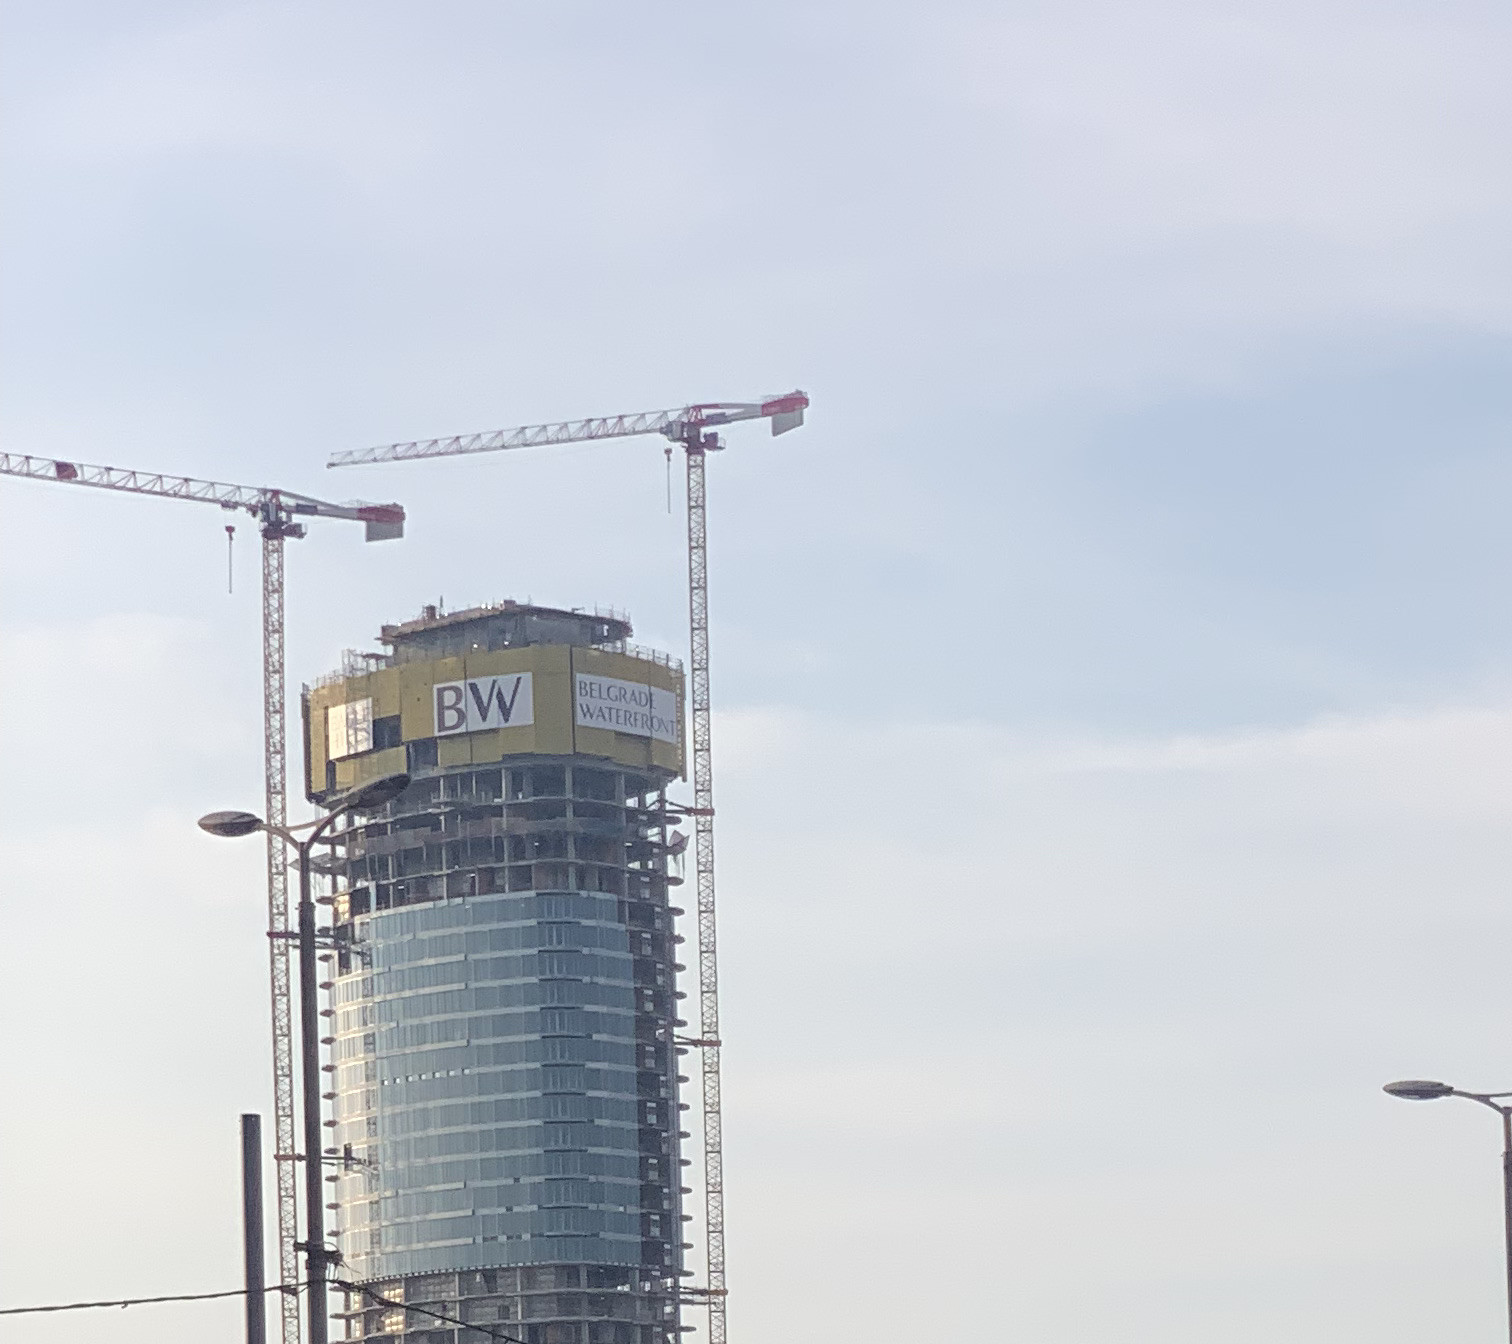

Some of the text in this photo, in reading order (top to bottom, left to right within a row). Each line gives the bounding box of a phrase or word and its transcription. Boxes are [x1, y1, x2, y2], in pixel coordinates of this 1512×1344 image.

[435, 676, 522, 733] BW
[578, 680, 657, 710] BELGRADE
[580, 703, 675, 736] WATERFRONT
